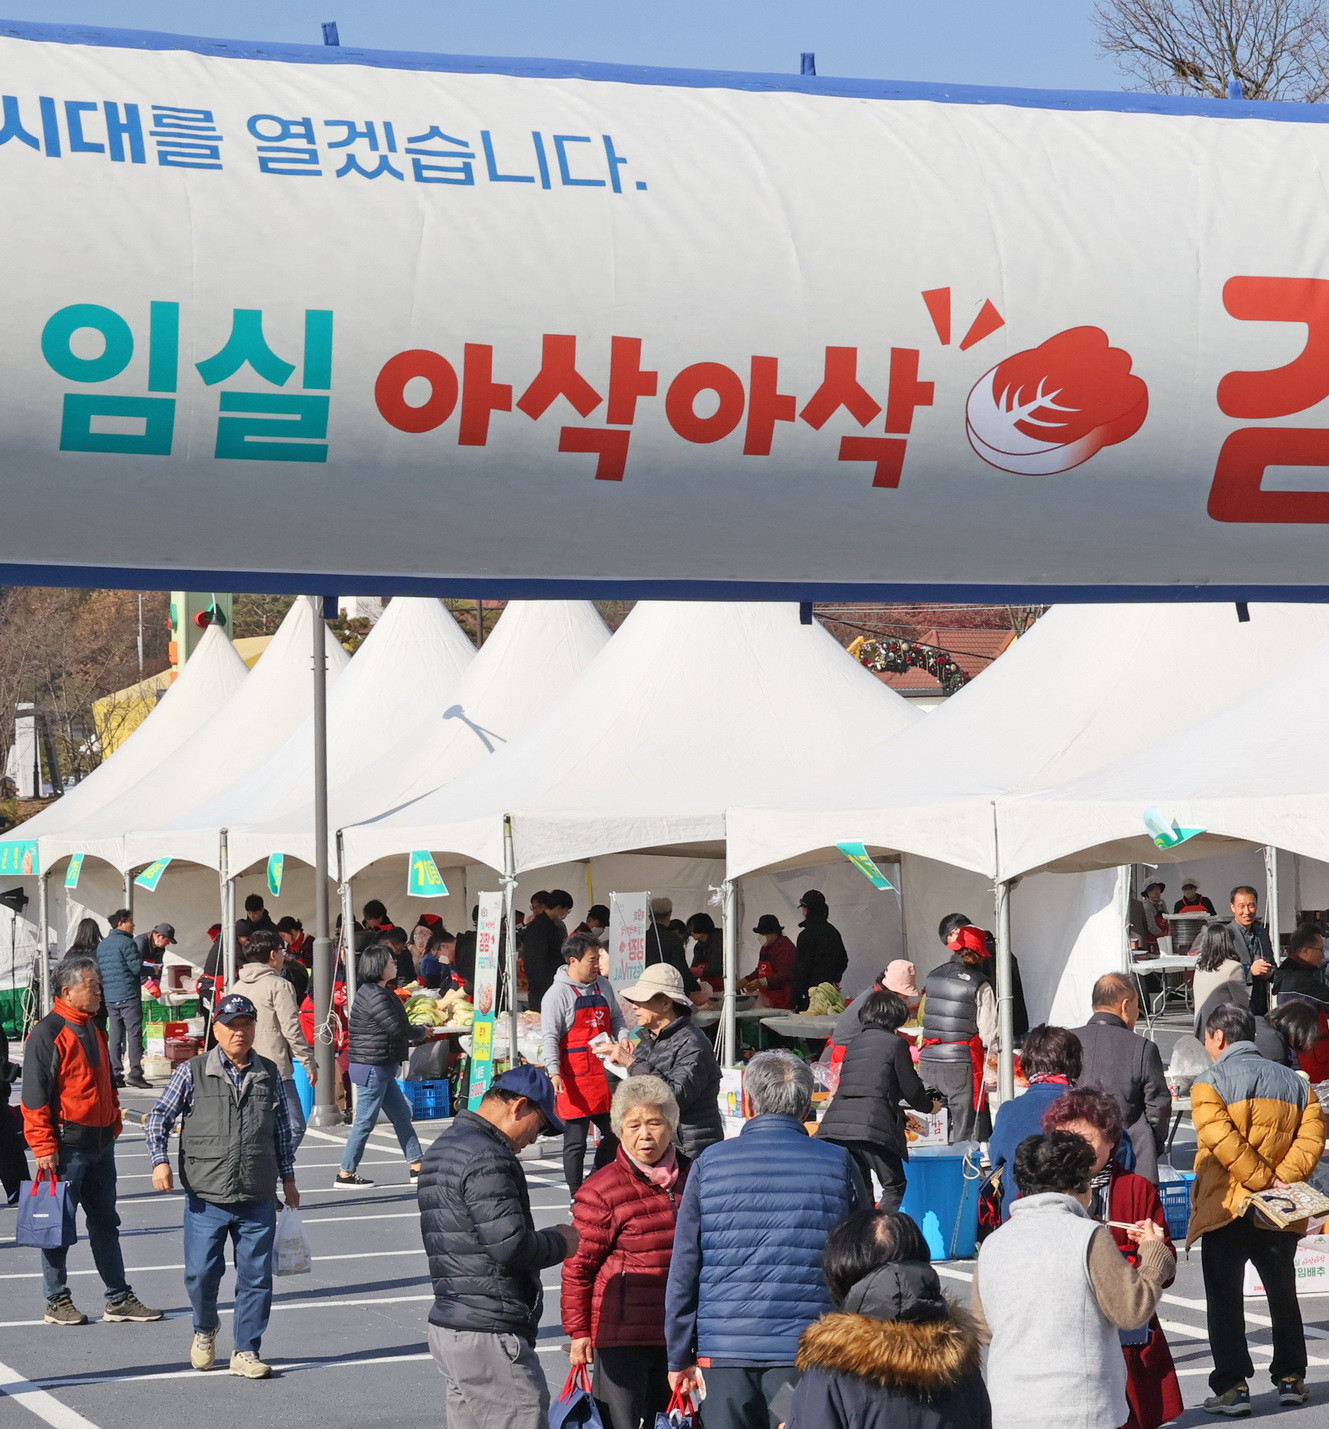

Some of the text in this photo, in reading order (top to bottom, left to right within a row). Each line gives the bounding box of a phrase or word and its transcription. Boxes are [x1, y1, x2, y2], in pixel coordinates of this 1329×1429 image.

[0, 96, 648, 193] 시대를 열겠습니다.
[41, 301, 334, 463] 임실
[374, 333, 935, 489] 아삭아삭
[1295, 1266, 1326, 1278] 임배추
